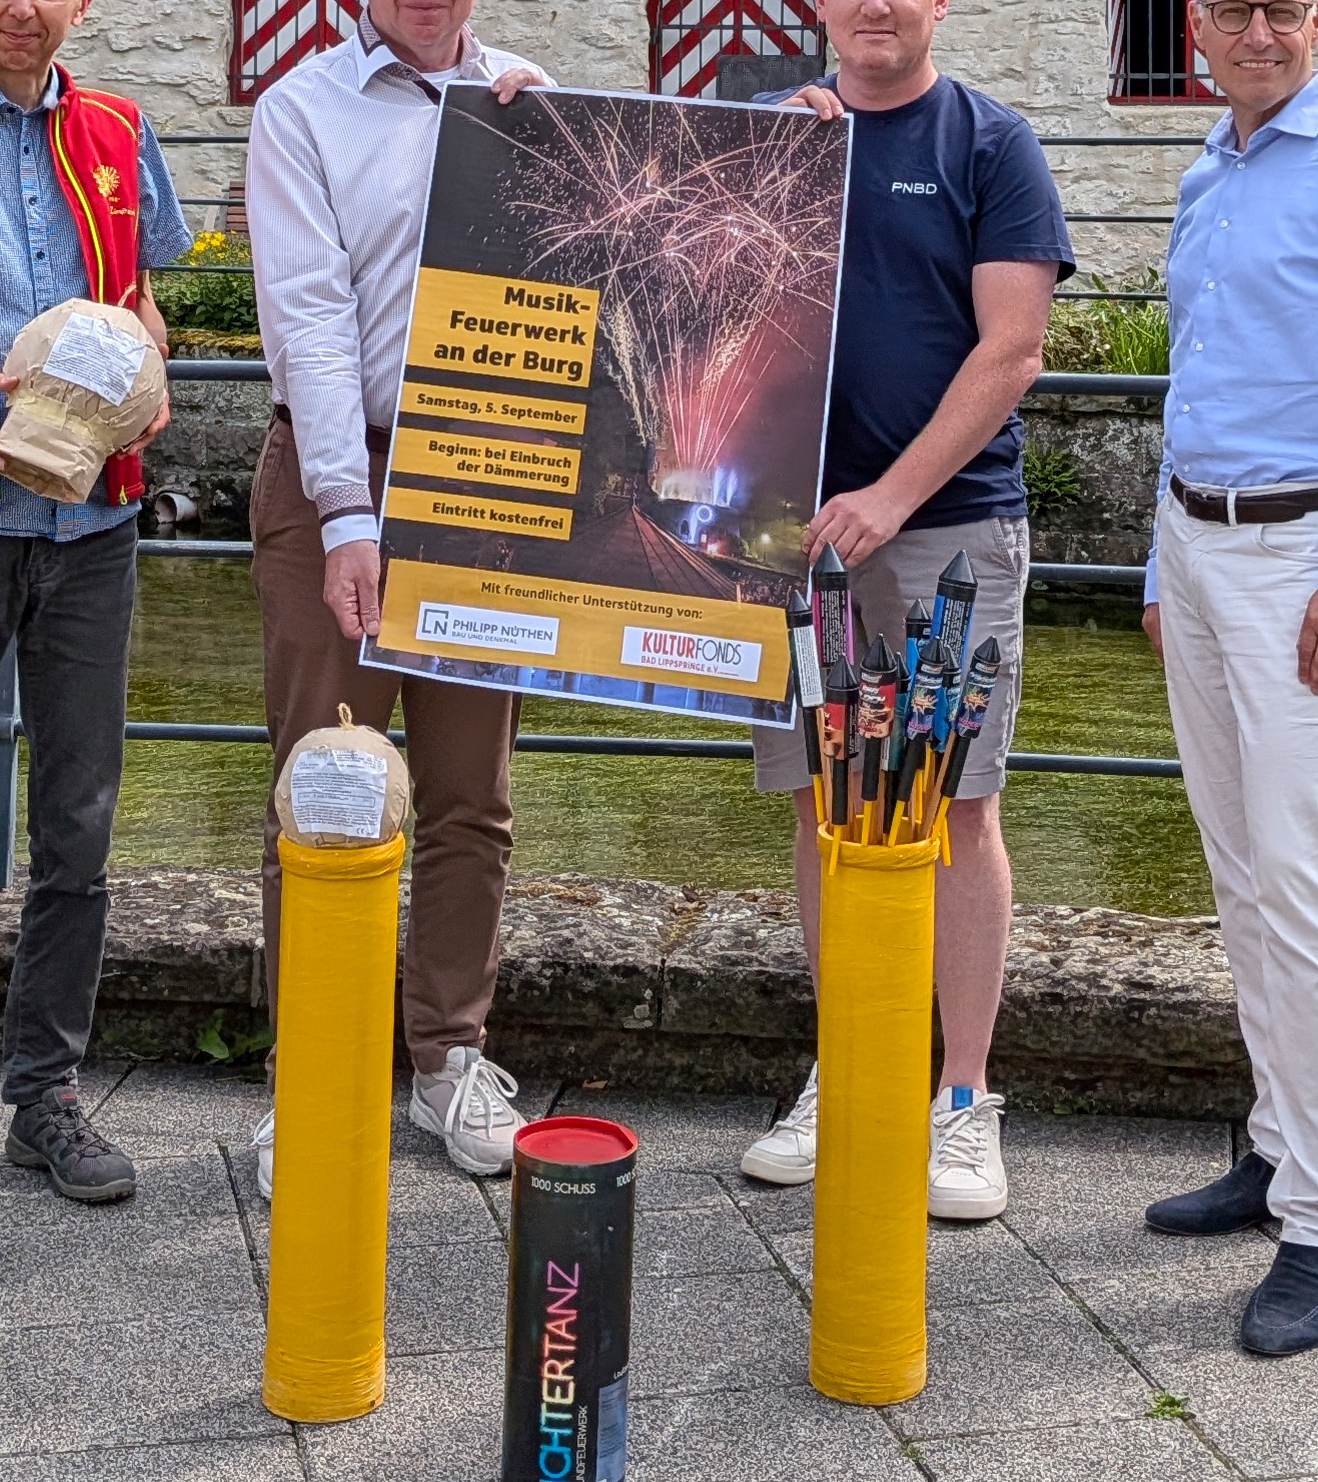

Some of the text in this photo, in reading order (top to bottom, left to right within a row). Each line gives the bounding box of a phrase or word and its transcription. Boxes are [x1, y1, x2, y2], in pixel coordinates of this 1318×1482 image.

[891, 181, 938, 195] PNBD
[504, 285, 591, 315] Musik-
[449, 309, 587, 346] Feuerwerk
[434, 343, 584, 382] an der Burg
[416, 392, 578, 424] Samstag, 5. September
[428, 439, 572, 469] Beginn: bei Einbruch
[456, 460, 570, 488] der Dämmerung
[432, 501, 564, 530] Eintritt kostenfrei
[480, 581, 703, 620] Mit freundlicher Unterstützung von:
[451, 631, 467, 639] BAU
[468, 633, 483, 641] UND
[452, 619, 498, 635] PHILIPP
[641, 631, 742, 666] KULTURFONDS
[641, 655, 656, 665] BAD
[531, 1175, 596, 1195] 1000 SCHUSS
